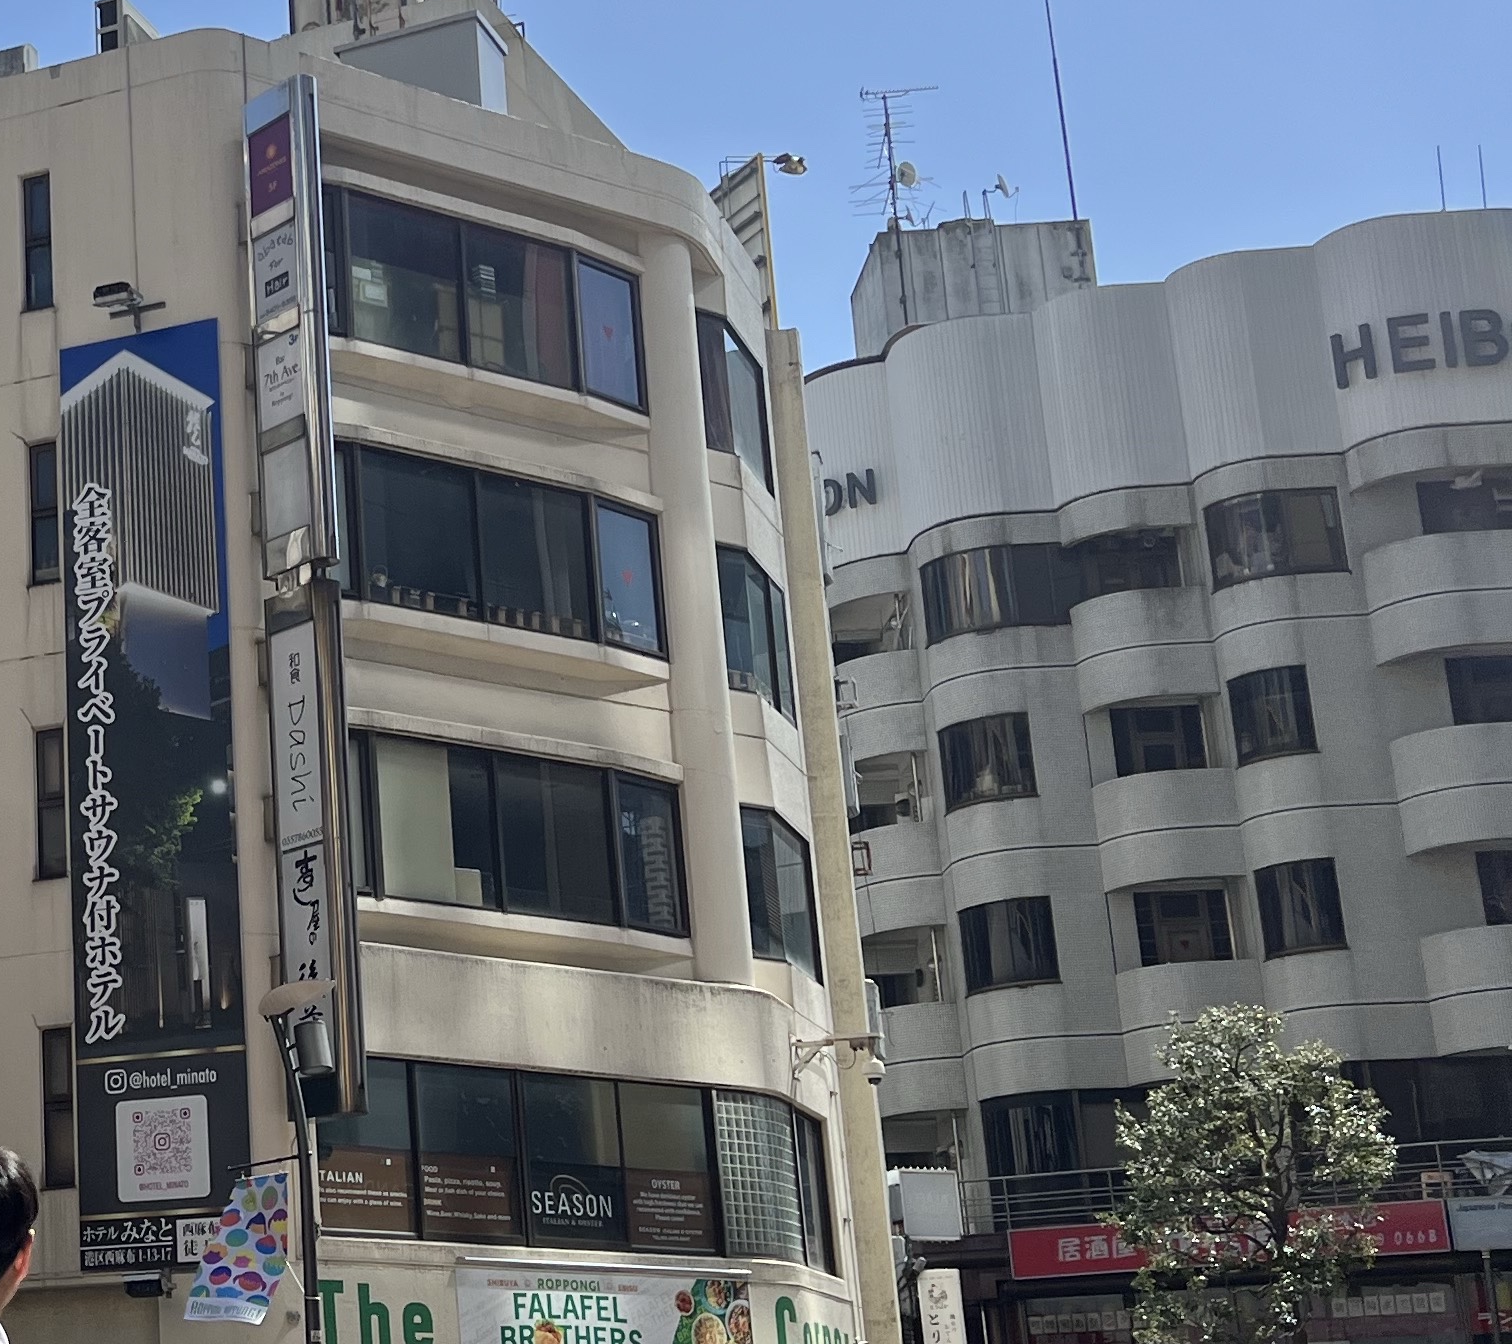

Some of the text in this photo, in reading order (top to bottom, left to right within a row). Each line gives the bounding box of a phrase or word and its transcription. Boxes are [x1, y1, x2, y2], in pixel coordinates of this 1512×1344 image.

[266, 276, 289, 297] Hair
[1330, 309, 1512, 390] HEIB
[263, 369, 279, 388] 7th
[289, 652, 301, 684] 和食
[288, 694, 315, 812] Dashi
[129, 1067, 217, 1090] @hotel_minato
[531, 1190, 613, 1218] SEASON
[537, 1277, 601, 1292] ROPPONGI
[513, 1292, 628, 1324] FALAFEL
